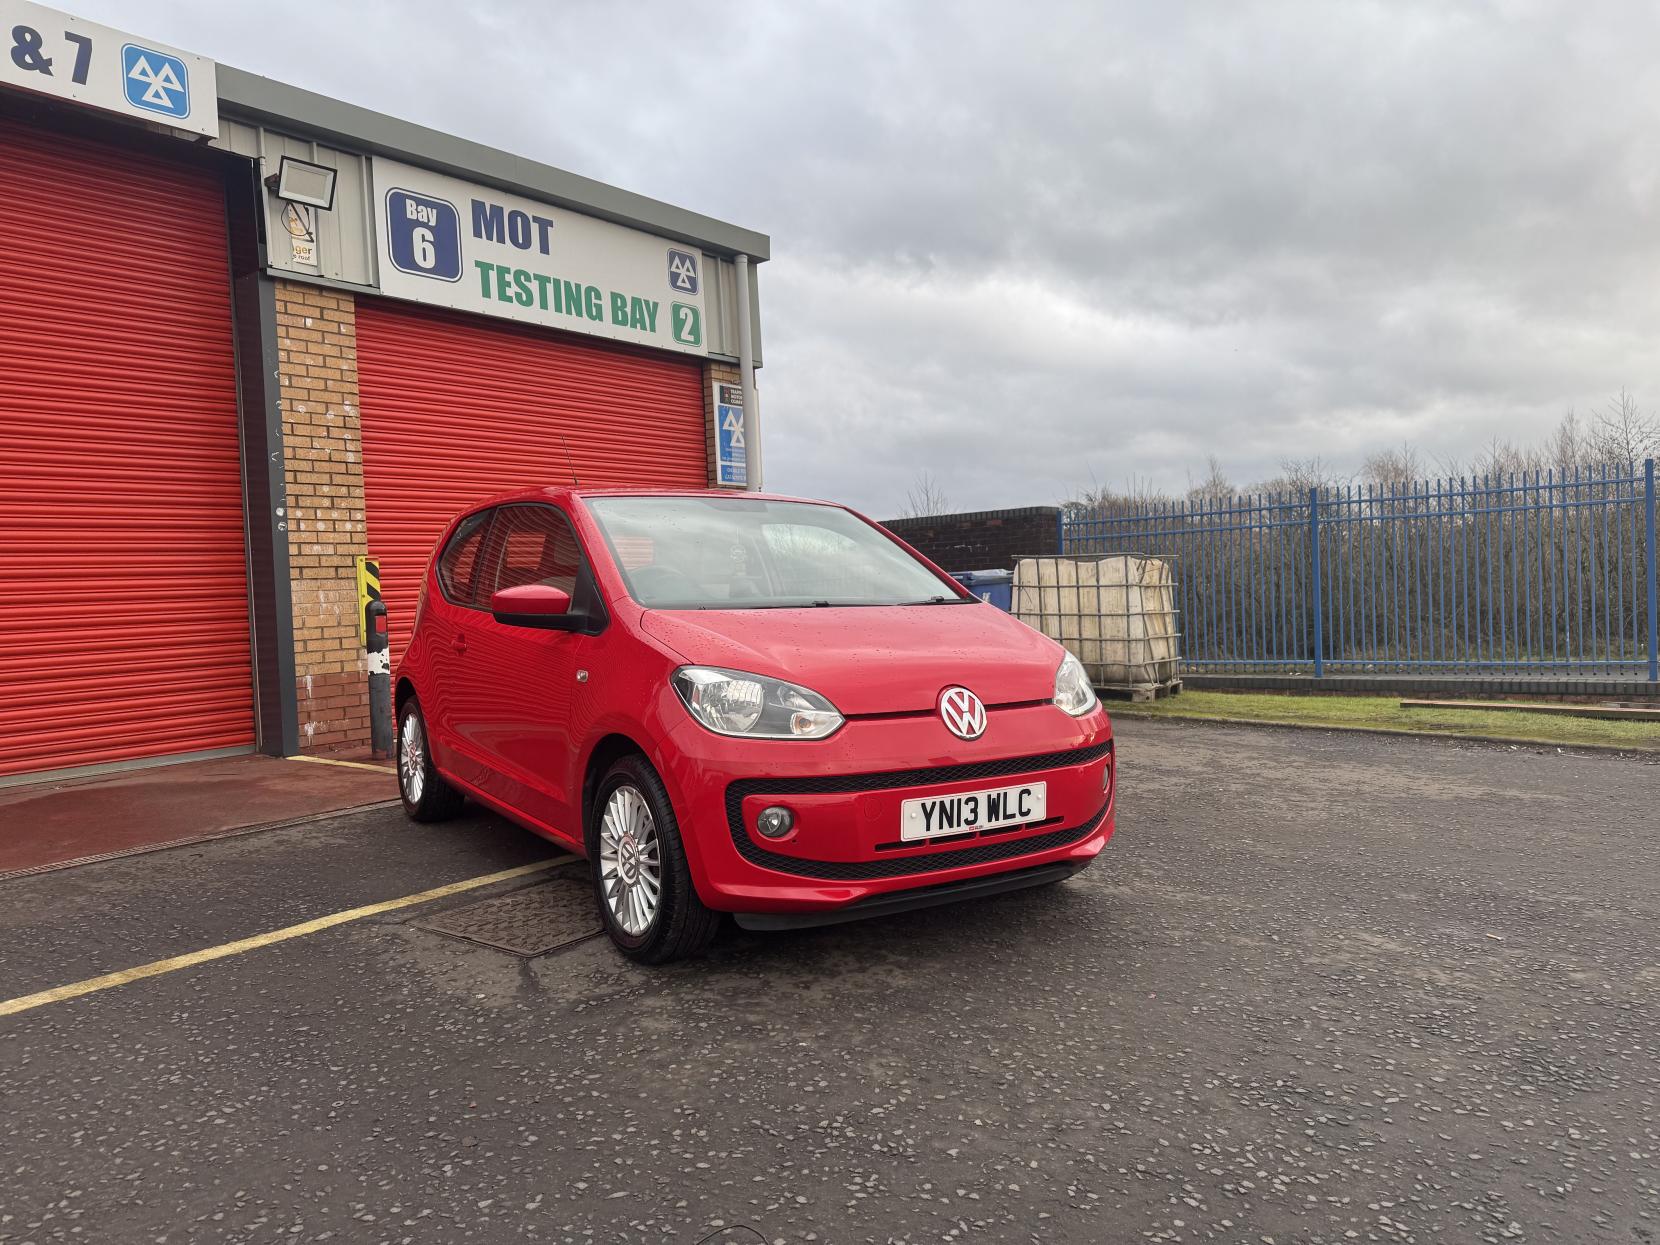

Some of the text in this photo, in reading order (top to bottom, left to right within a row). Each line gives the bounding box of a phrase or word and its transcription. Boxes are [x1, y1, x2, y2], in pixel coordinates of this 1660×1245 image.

[11, 25, 93, 86] & 7
[405, 198, 437, 227] Bay
[471, 198, 554, 256] MOT
[293, 245, 312, 255] ger
[412, 227, 436, 269] 6
[474, 260, 695, 341] TESTING BAY 2
[940, 687, 988, 738] VW
[920, 788, 1032, 832] YN13 WLC
